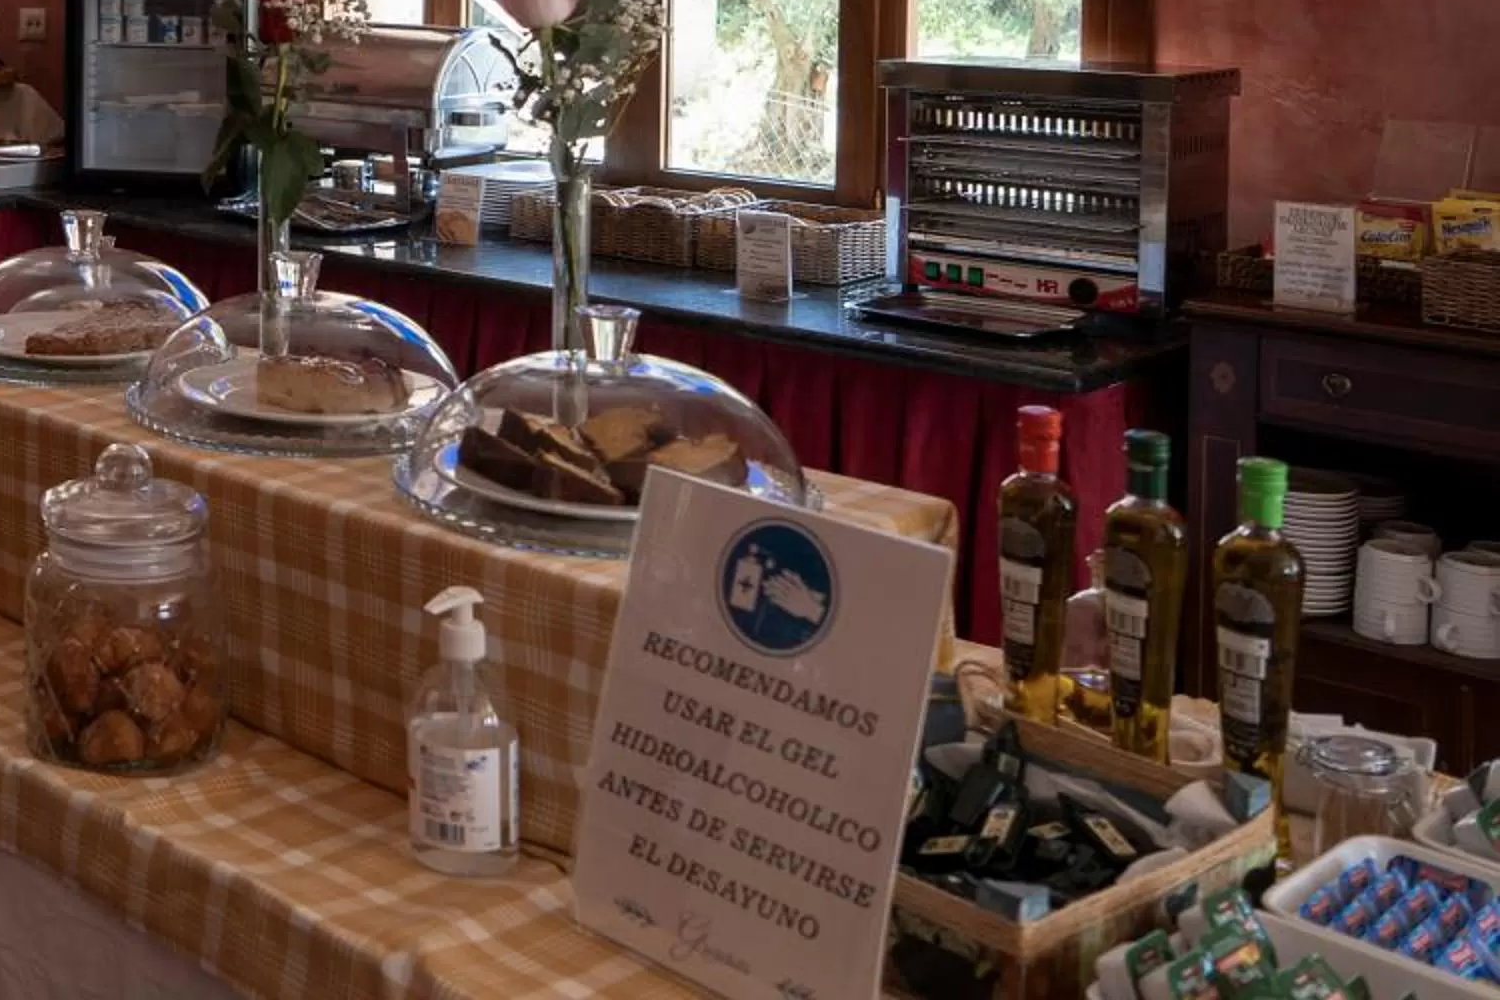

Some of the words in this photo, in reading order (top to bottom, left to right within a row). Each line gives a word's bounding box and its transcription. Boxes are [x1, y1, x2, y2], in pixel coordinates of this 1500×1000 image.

[642, 631, 880, 738] RECOMENDAMOS
[662, 690, 736, 738] USAR
[738, 721, 775, 754] EL
[779, 737, 840, 780] GEL
[597, 769, 684, 822] ANTES
[686, 808, 728, 842] DE
[730, 826, 878, 910] SERVIRSE
[610, 721, 883, 854] HIDROALCOHOLICO
[628, 833, 663, 868] EL
[666, 852, 821, 941] DESAYUNO
